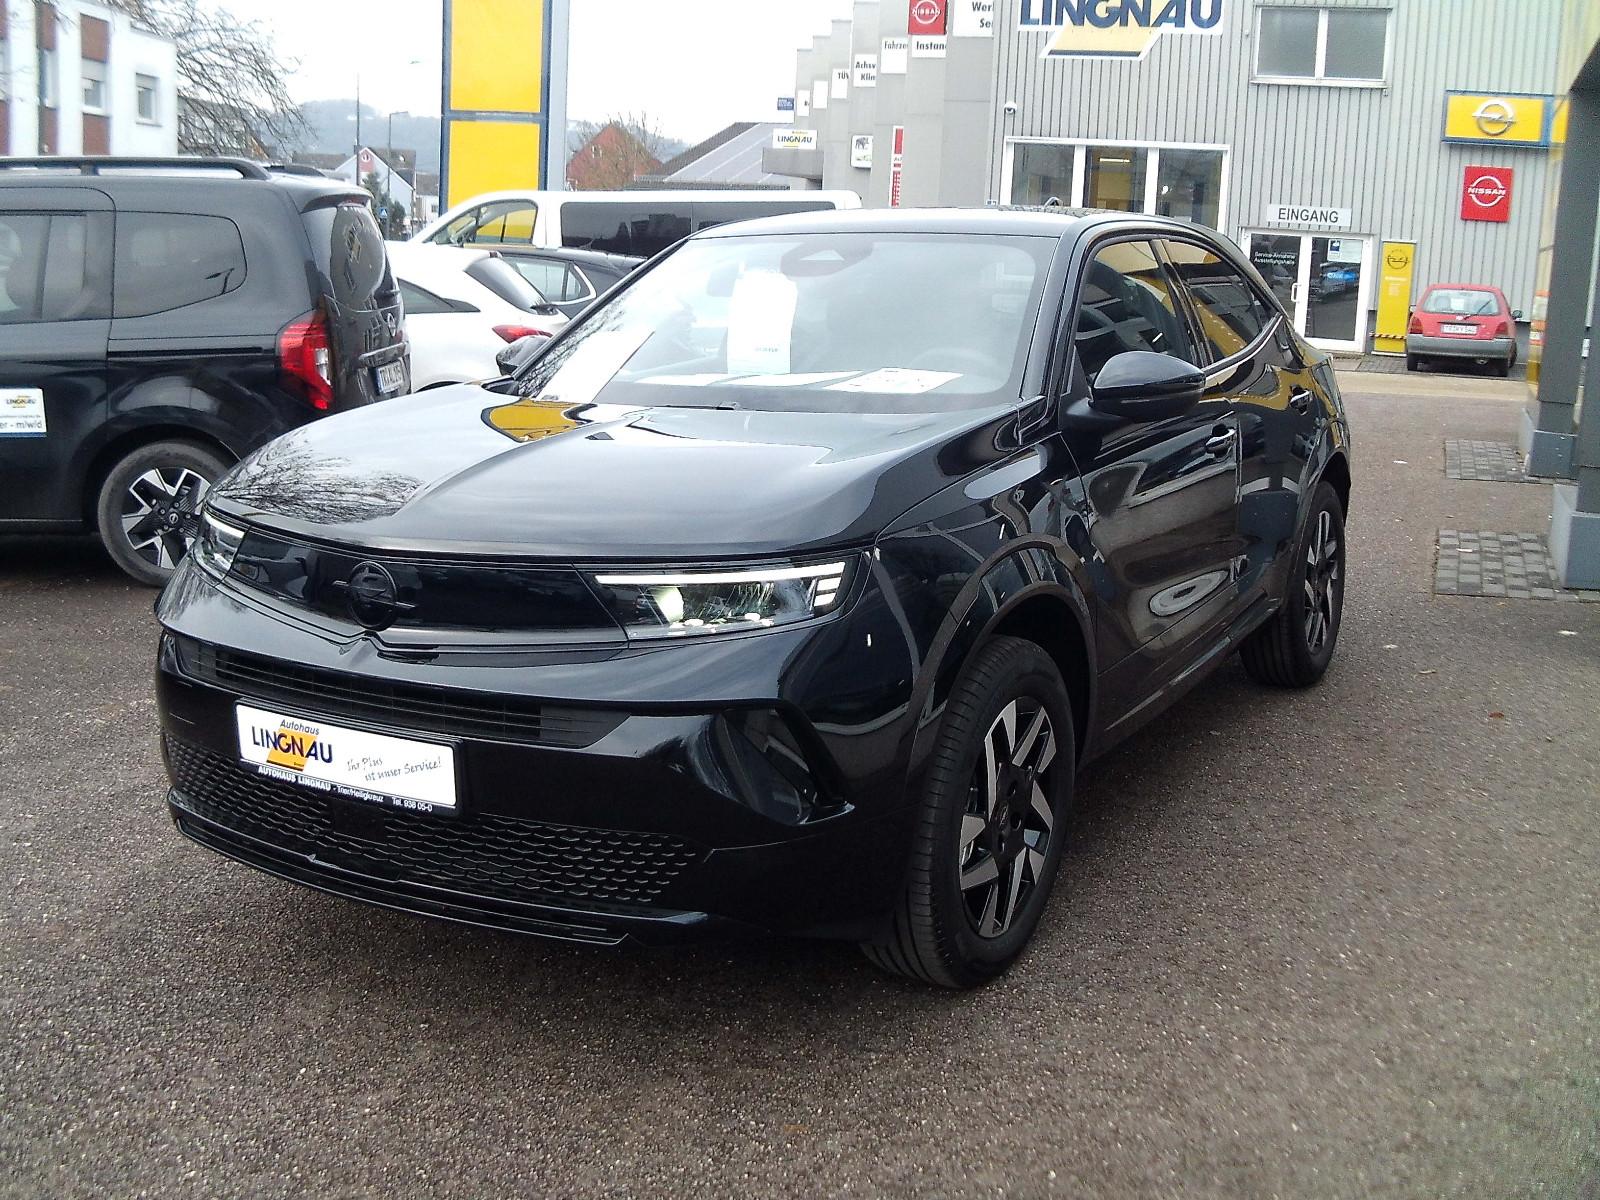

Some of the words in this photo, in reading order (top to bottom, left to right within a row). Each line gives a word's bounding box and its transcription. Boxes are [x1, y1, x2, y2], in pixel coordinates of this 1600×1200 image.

[1020, 0, 1222, 29] LINGNAU
[884, 39, 908, 50] Fahrze
[916, 41, 947, 51] Instan
[777, 135, 812, 144] LINGNAU
[1467, 187, 1507, 196] NISSAN
[1278, 207, 1339, 224] EINGANG
[279, 718, 320, 736] Autohaus
[251, 725, 333, 764] LINGNAU
[361, 756, 383, 771] Plus
[378, 768, 402, 780] unser
[404, 756, 442, 775] Service!
[258, 766, 297, 783] AUTOHAUS
[297, 775, 332, 793] LINGNAU
[391, 796, 403, 806] Tel.
[403, 799, 416, 809] 938
[417, 802, 433, 812] 05-0
